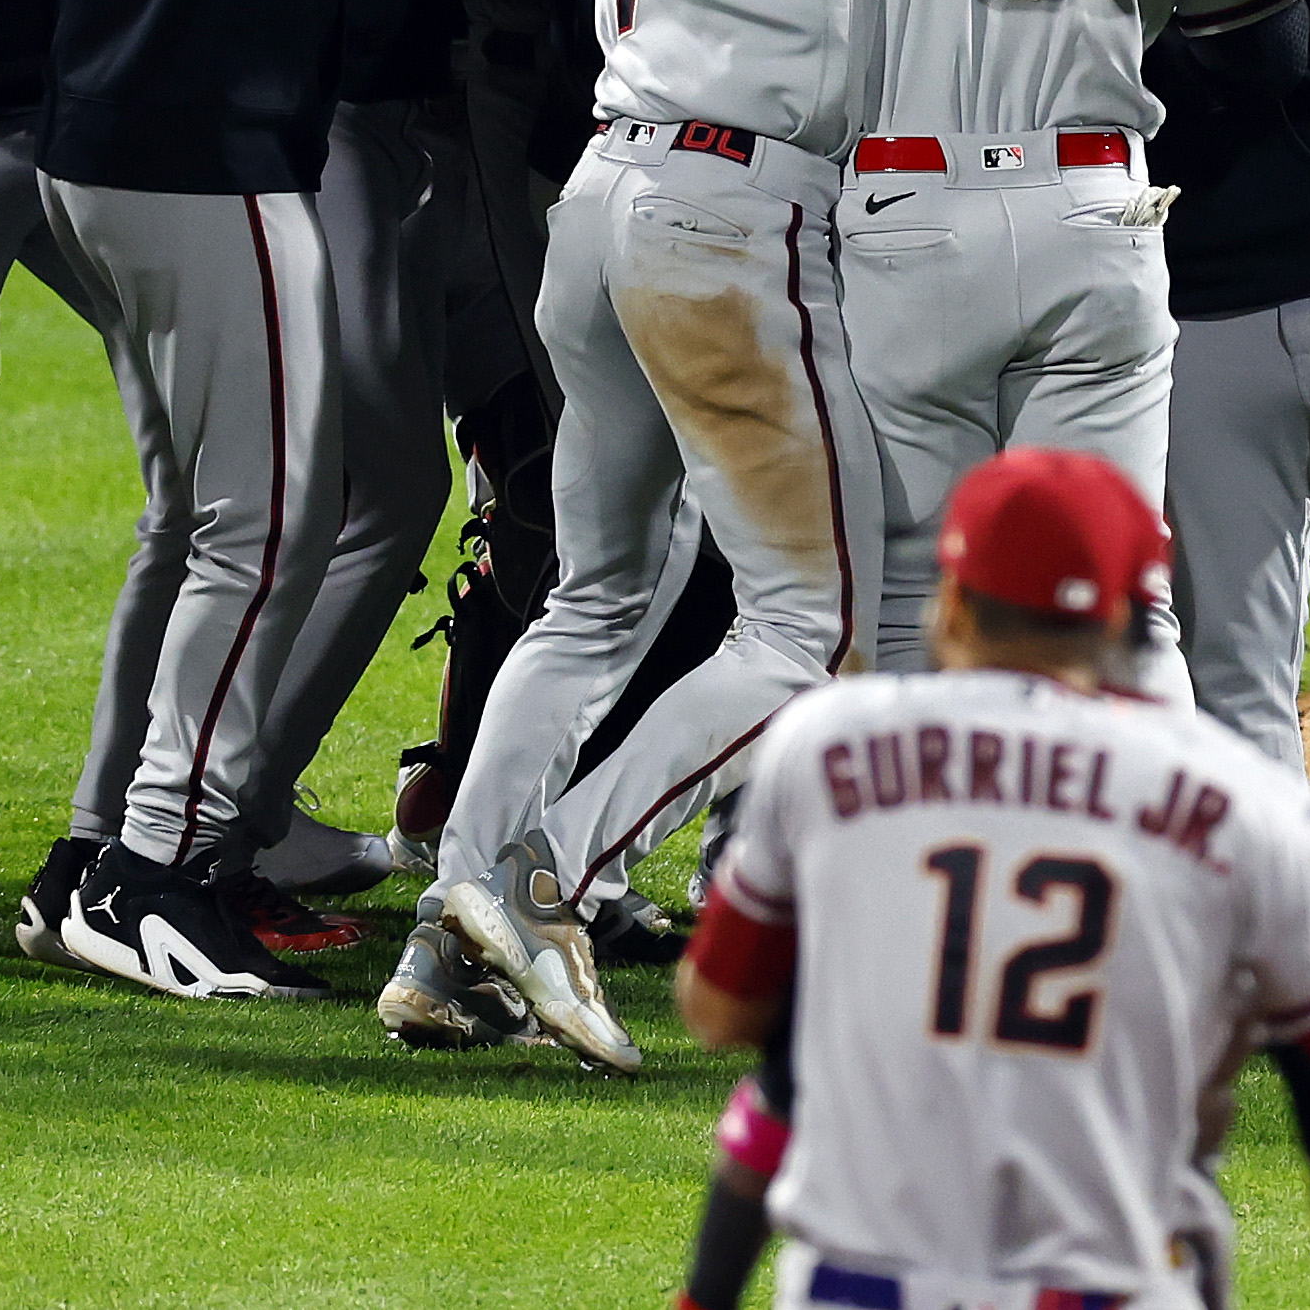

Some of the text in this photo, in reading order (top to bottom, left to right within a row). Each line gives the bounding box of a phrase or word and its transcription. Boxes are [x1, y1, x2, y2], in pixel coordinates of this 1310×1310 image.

[823, 725, 1233, 877] GURRIEL JR.
[924, 837, 1120, 1055] 12
